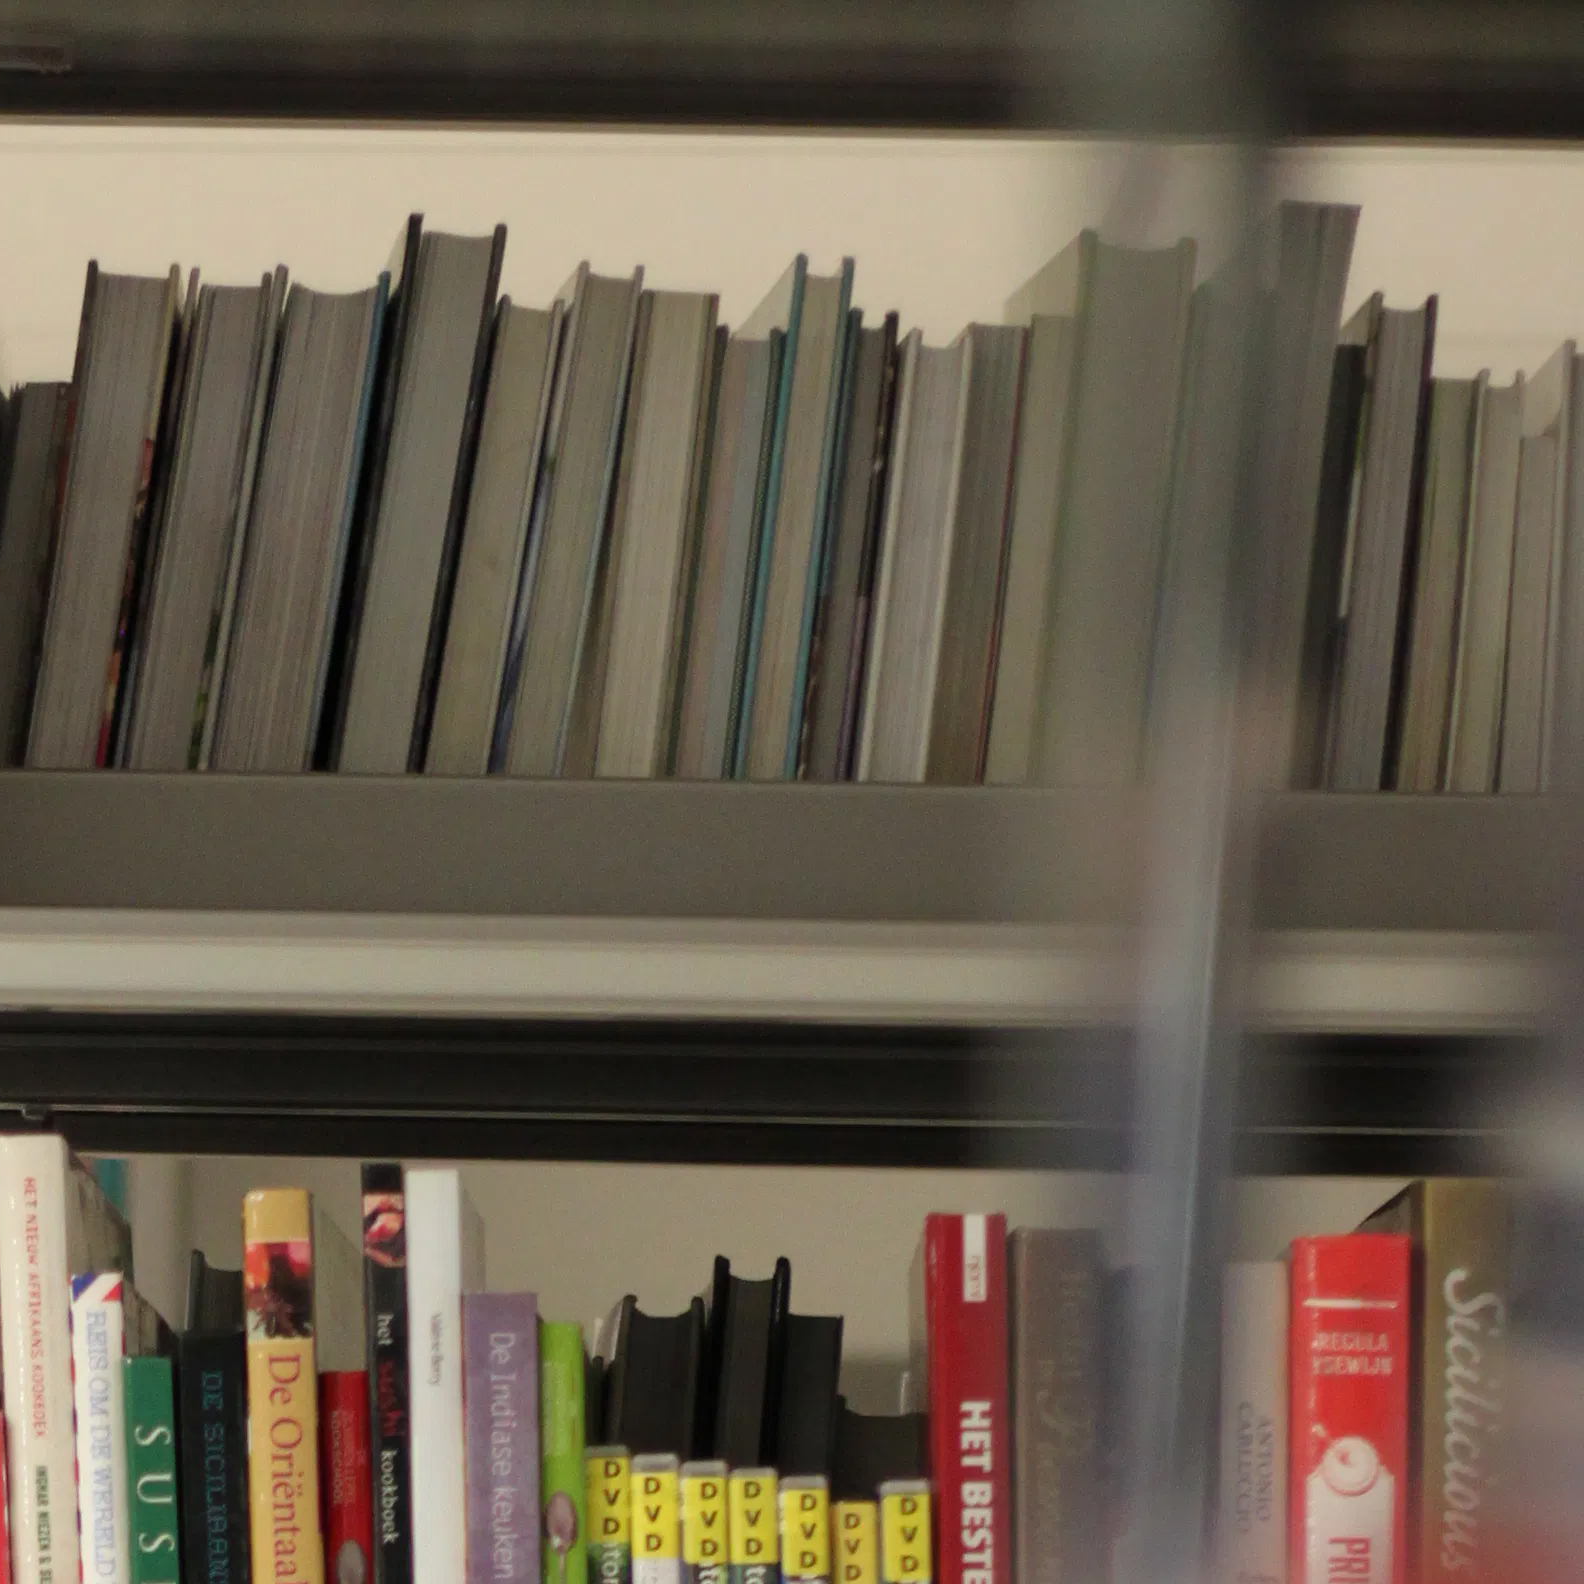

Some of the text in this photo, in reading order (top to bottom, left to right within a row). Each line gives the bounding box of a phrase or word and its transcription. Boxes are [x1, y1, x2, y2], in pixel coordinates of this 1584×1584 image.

[377, 1312, 395, 1347] het
[267, 1354, 302, 1406] De
[961, 1400, 993, 1473] HET
